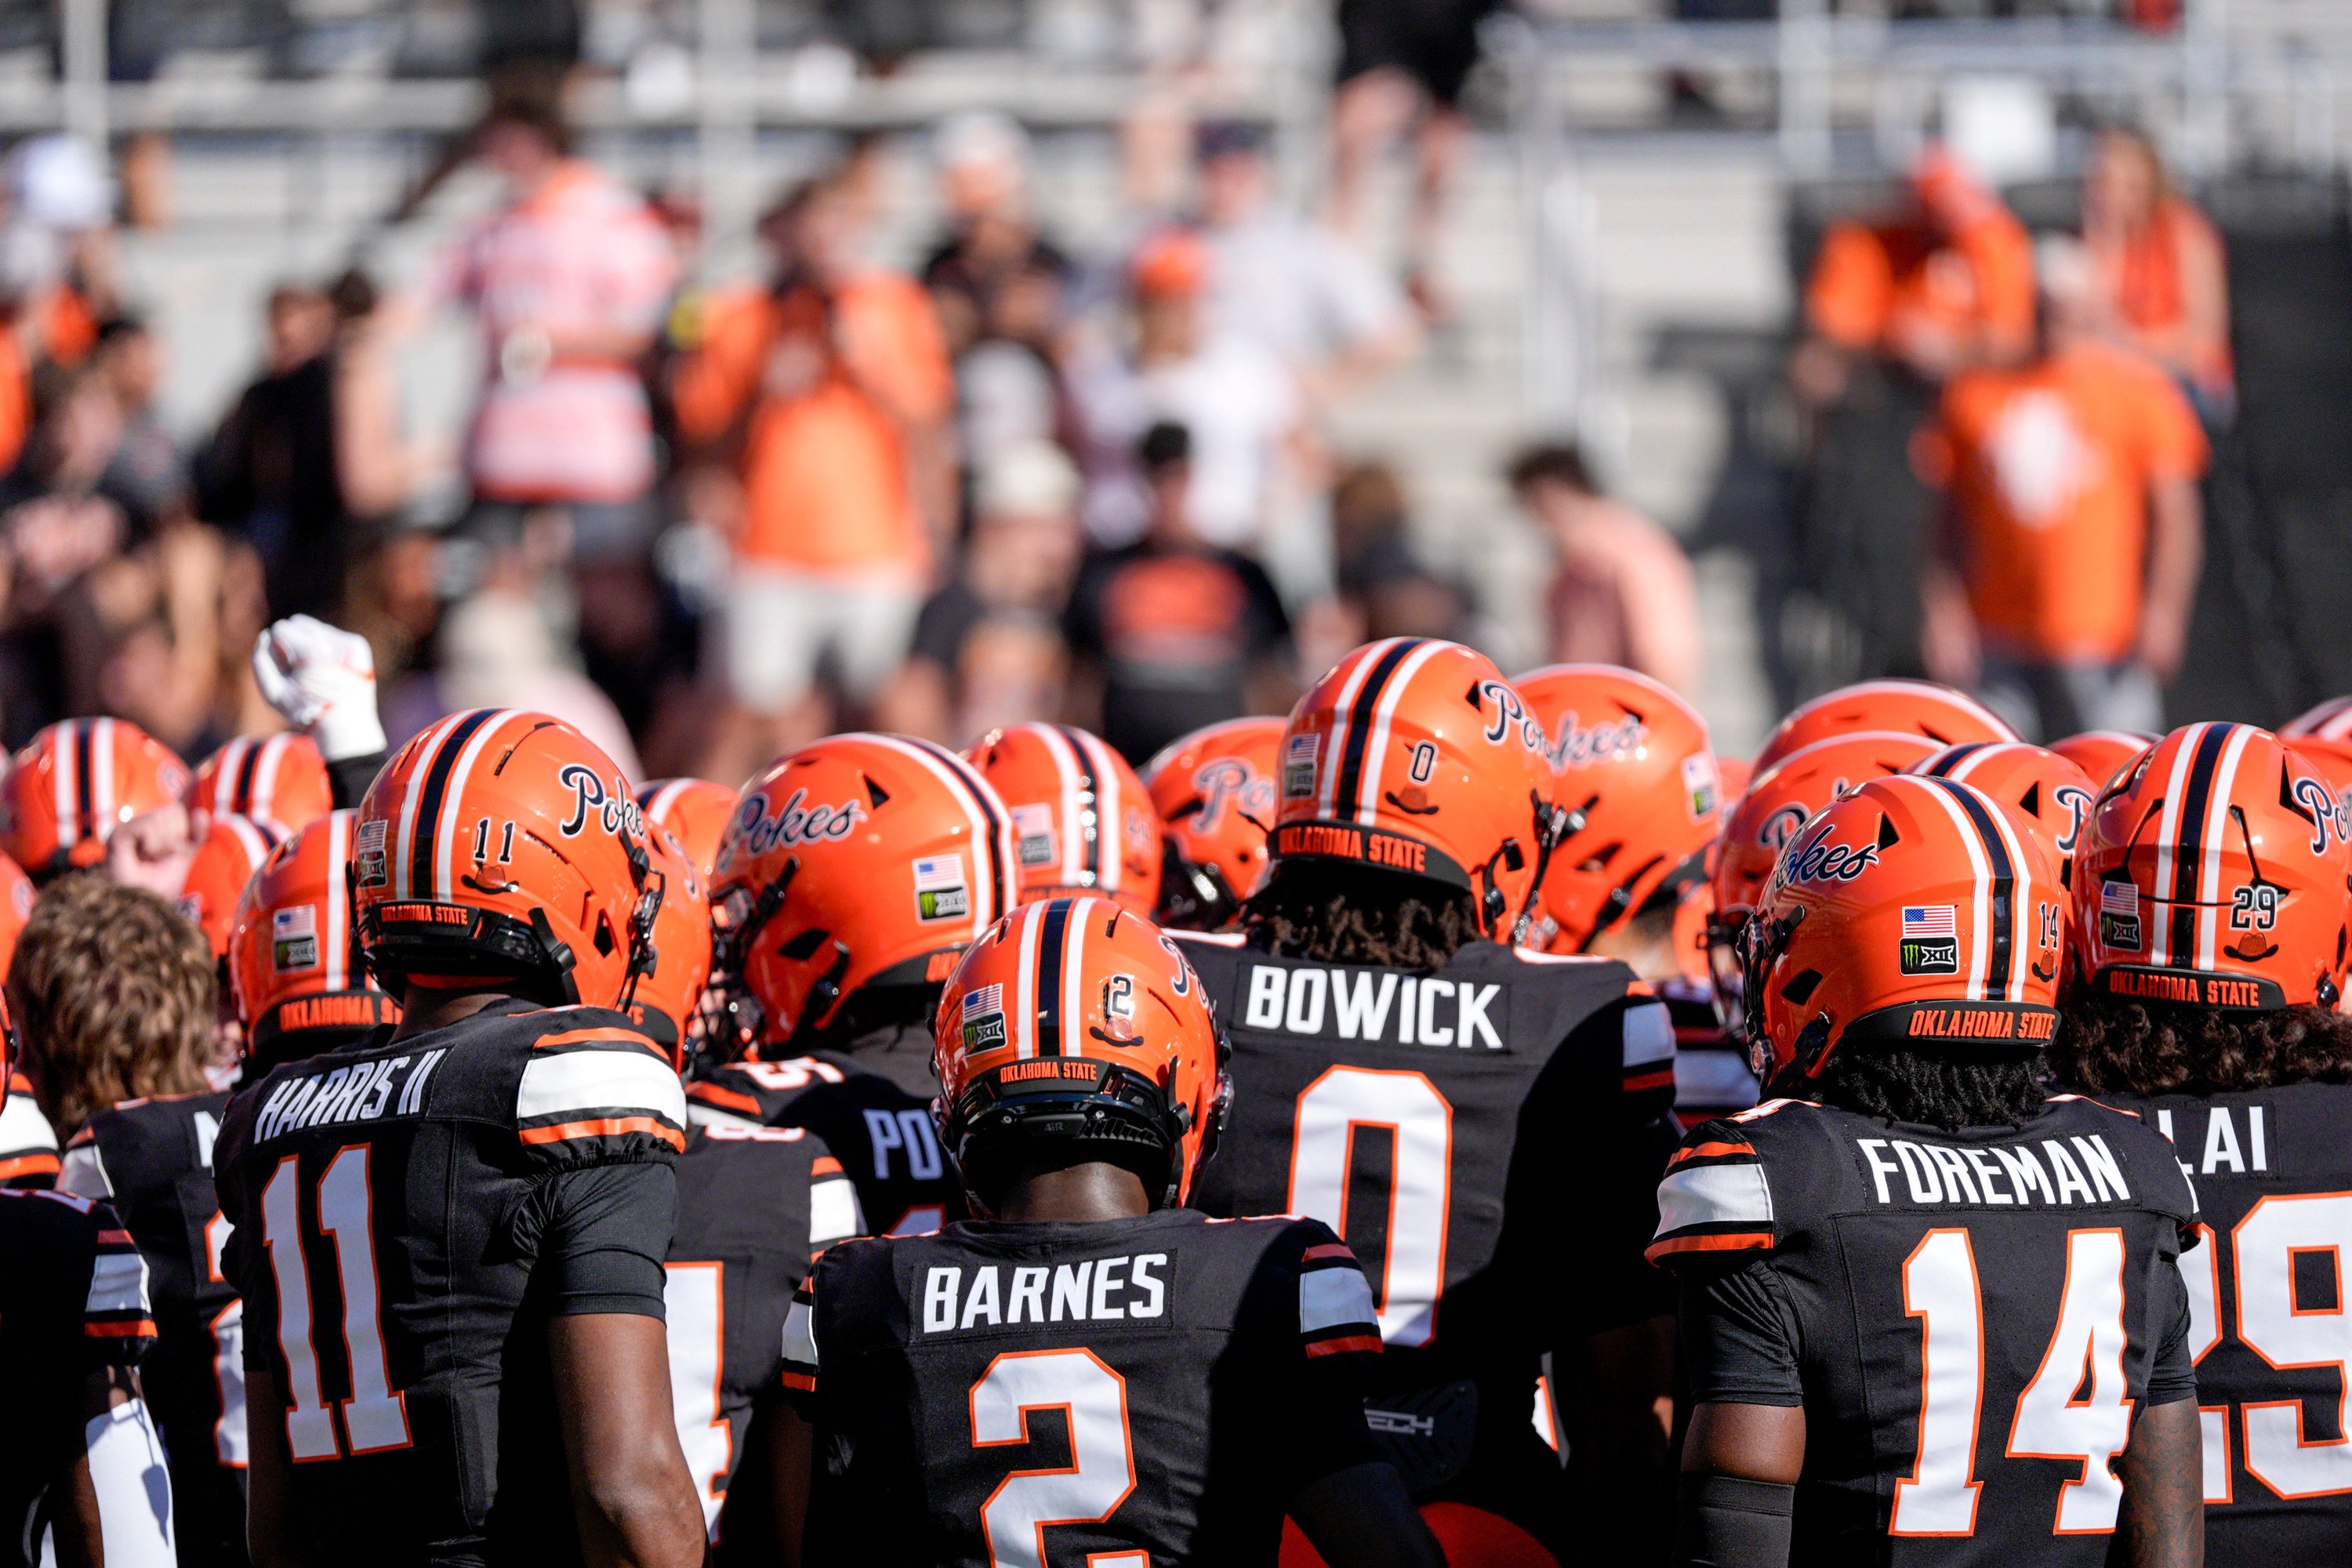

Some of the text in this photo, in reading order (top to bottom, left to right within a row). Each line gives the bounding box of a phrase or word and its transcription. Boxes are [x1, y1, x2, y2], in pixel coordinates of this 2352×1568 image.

[1407, 739, 1439, 786] 0
[473, 817, 515, 864] 11
[1278, 826, 1426, 873] OKLAHOMA STATE
[381, 904, 468, 925] OKLAHOMA STATE
[2038, 902, 2060, 949] 14
[2229, 884, 2278, 931] 29
[1109, 973, 1135, 1019] 2
[1245, 965, 1503, 1048] BOWICK
[2110, 971, 2259, 1007] OKLAHOMA STATE
[1908, 1010, 2056, 1040] OKLAHOMA STATE
[1000, 1061, 1097, 1083] OKLAHOMA STATE
[254, 1056, 410, 1145] HARRIS
[397, 1048, 446, 1115] II
[1857, 1134, 2131, 1205] FOREMAN
[1287, 1064, 1453, 1348] 0
[261, 1142, 412, 1464] 11
[924, 1253, 1167, 1334] BARNES
[1889, 1227, 2135, 1537] 14
[969, 1347, 1152, 1568] 2
